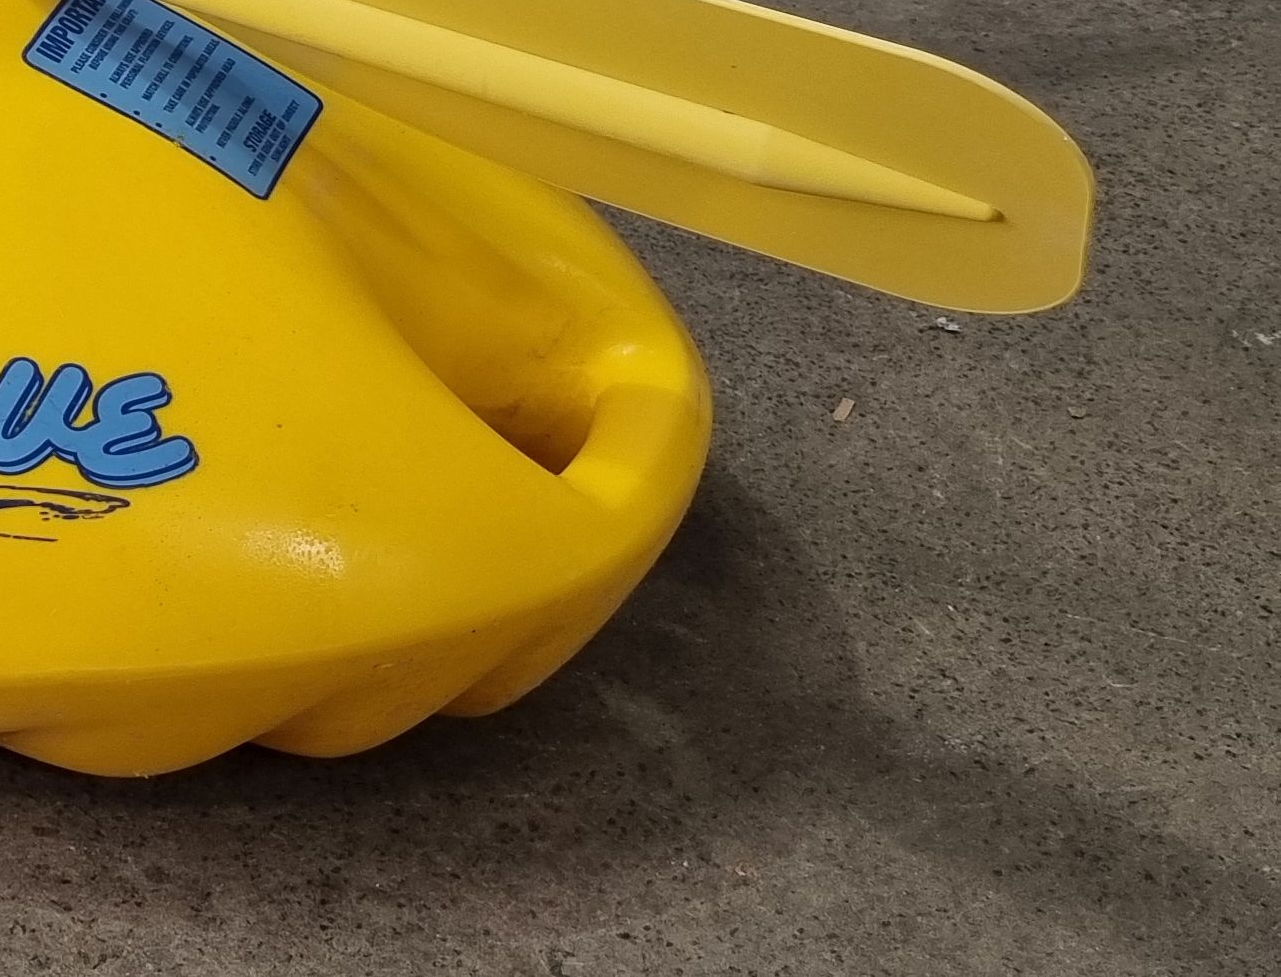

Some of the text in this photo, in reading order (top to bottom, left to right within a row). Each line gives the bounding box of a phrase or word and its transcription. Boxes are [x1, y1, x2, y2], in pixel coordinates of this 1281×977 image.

[70, 51, 91, 75] PLEASE
[84, 27, 109, 55] CONSIDER
[102, 17, 116, 31] THE
[88, 48, 108, 70] BEFORE
[102, 33, 119, 51] USING
[112, 22, 127, 37] THIS
[108, 26, 153, 84] ALWAYS USE APPROVED
[119, 61, 144, 90] PERSONAL
[137, 36, 161, 64] FLOTATION
[141, 81, 160, 102] MATCH
[153, 67, 170, 84] SKILL
[162, 60, 174, 71] TO
[180, 79, 191, 89] IN
[184, 52, 209, 83] POPULATED
[162, 97, 178, 114] TAKE
[171, 85, 187, 101] CARE
[184, 56, 236, 127] ALWAYS USE APPROVED HEAD
[275, 119, 287, 131] OF
[280, 98, 300, 122] DIRECT
[215, 130, 232, 149] NEVER
[225, 111, 244, 133] PADDLE
[241, 108, 277, 153] STORAGE
[268, 127, 282, 142] OUT
[270, 133, 292, 162] SUNLIGHT
